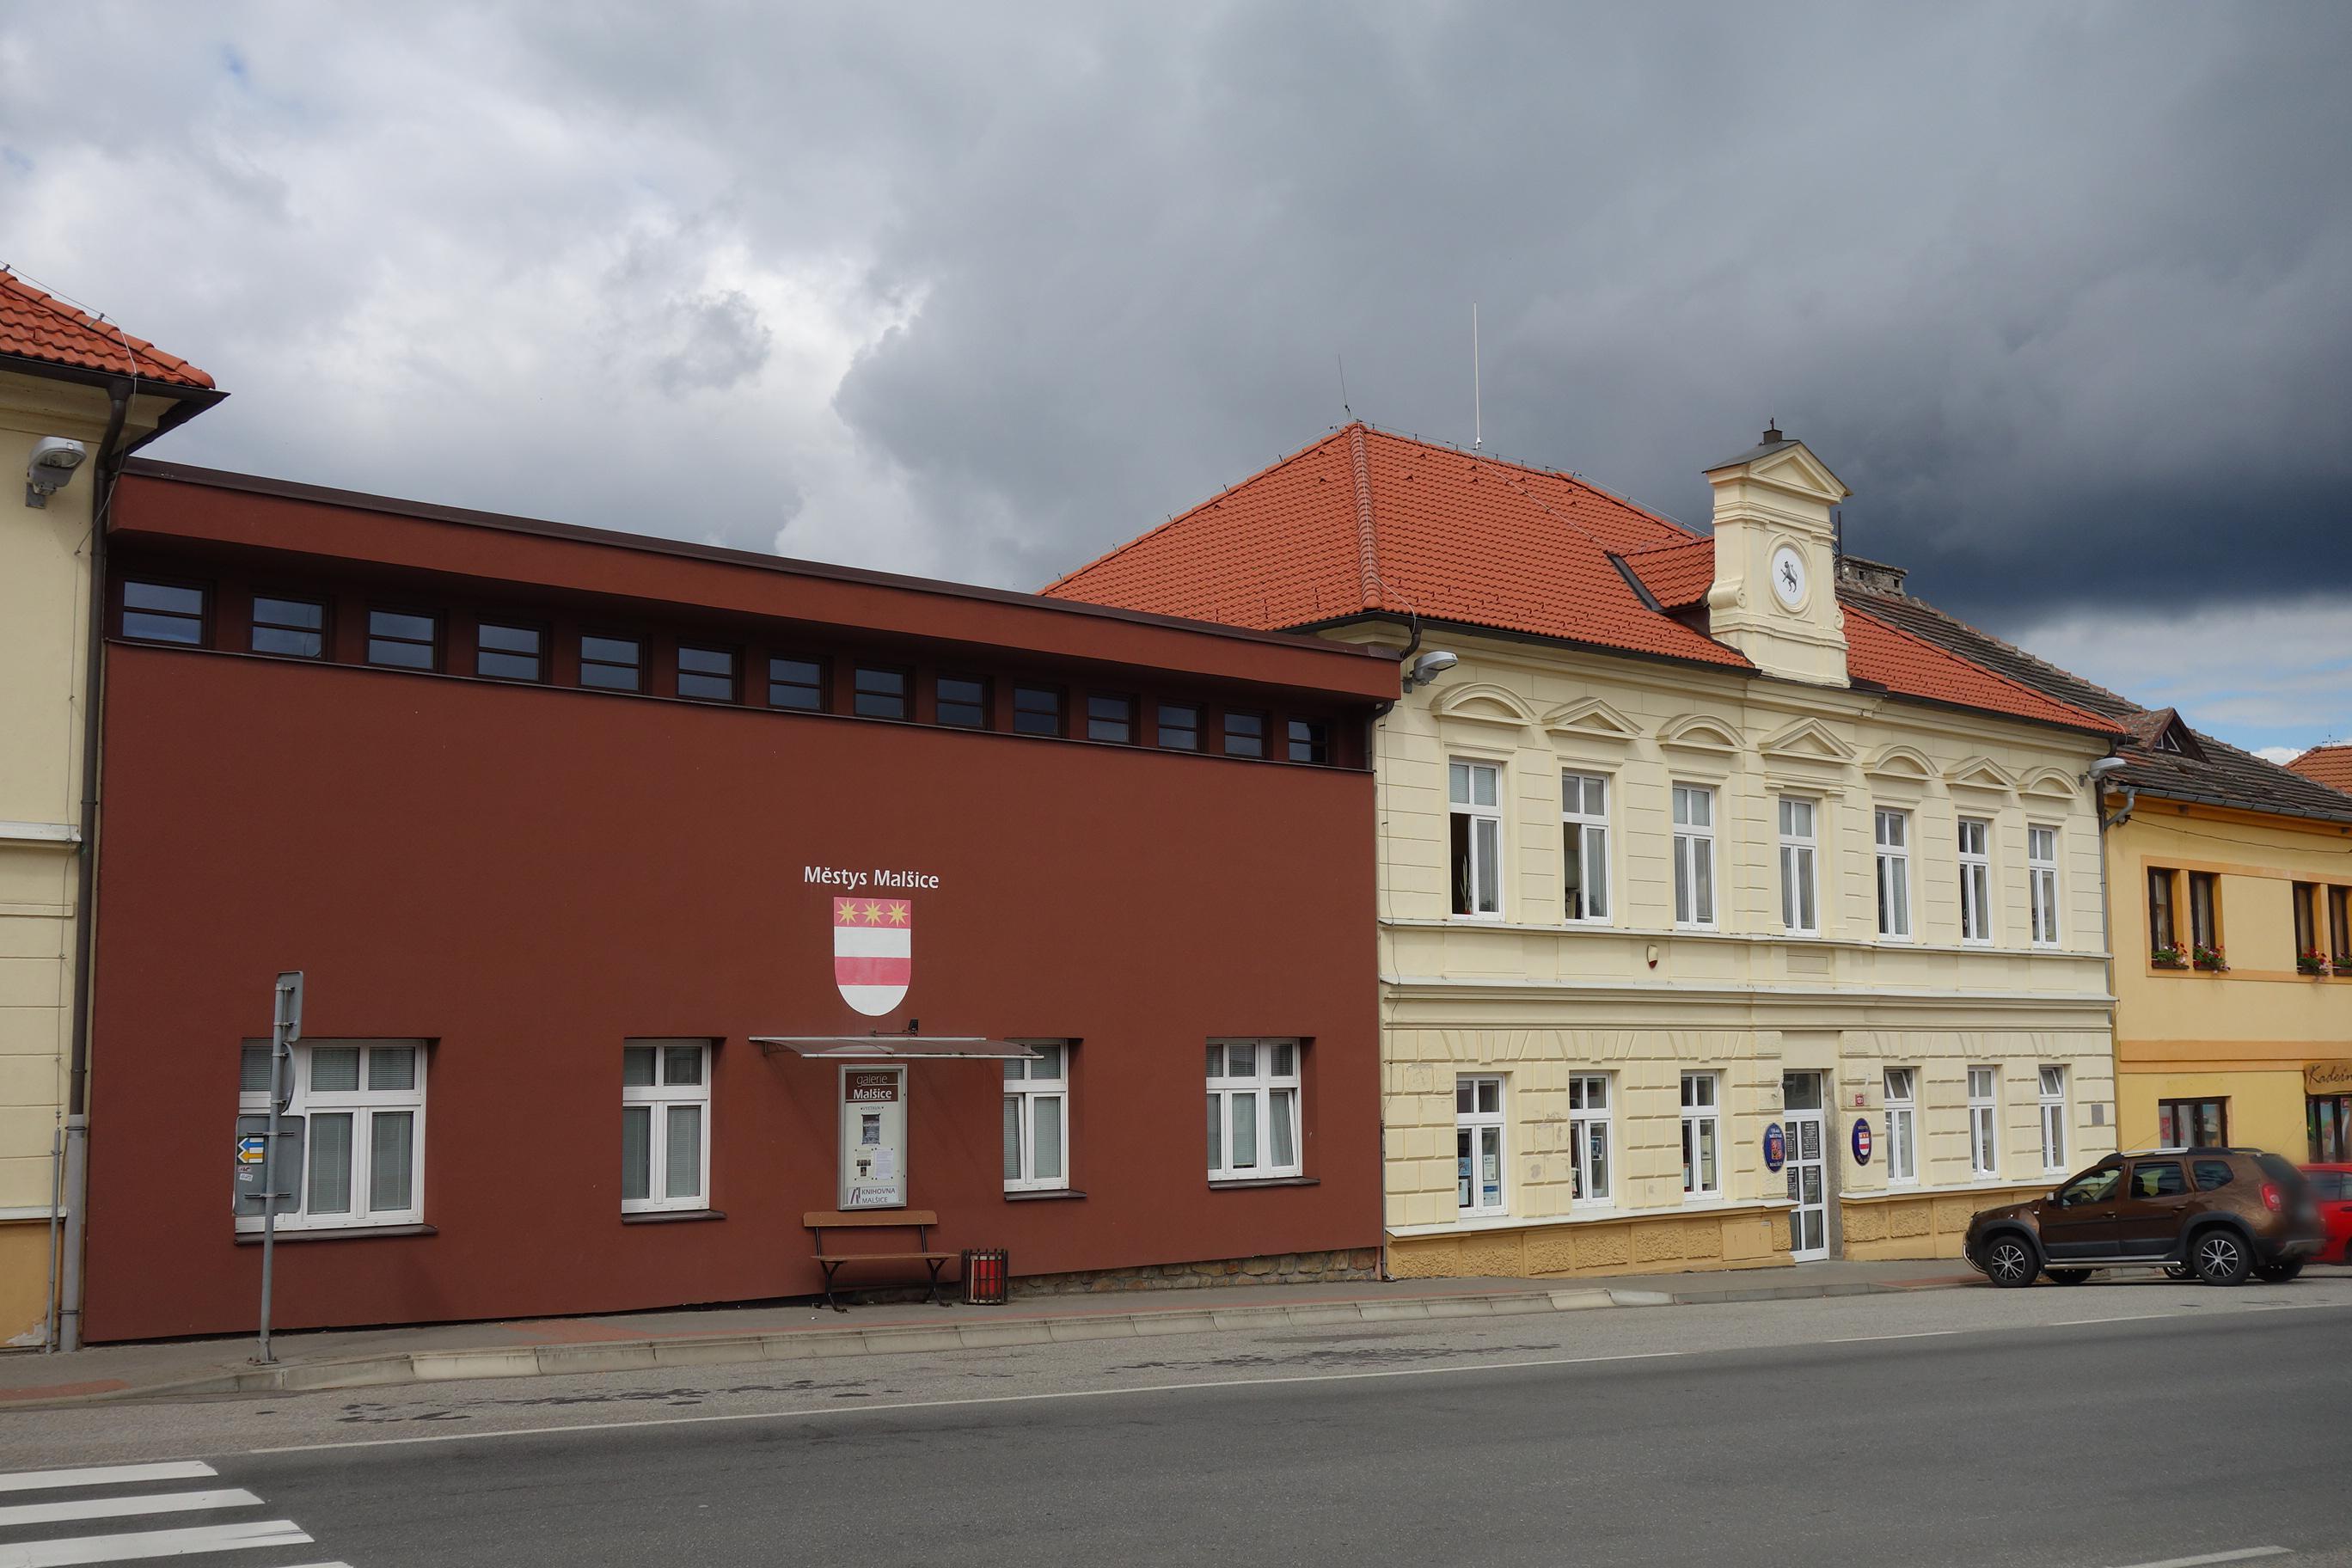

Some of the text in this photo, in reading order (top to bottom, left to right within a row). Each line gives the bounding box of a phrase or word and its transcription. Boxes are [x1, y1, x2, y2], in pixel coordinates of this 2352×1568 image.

[804, 866, 940, 890] Městys Malšice
[856, 1075, 888, 1087] galerie
[853, 1088, 892, 1099] Malšice
